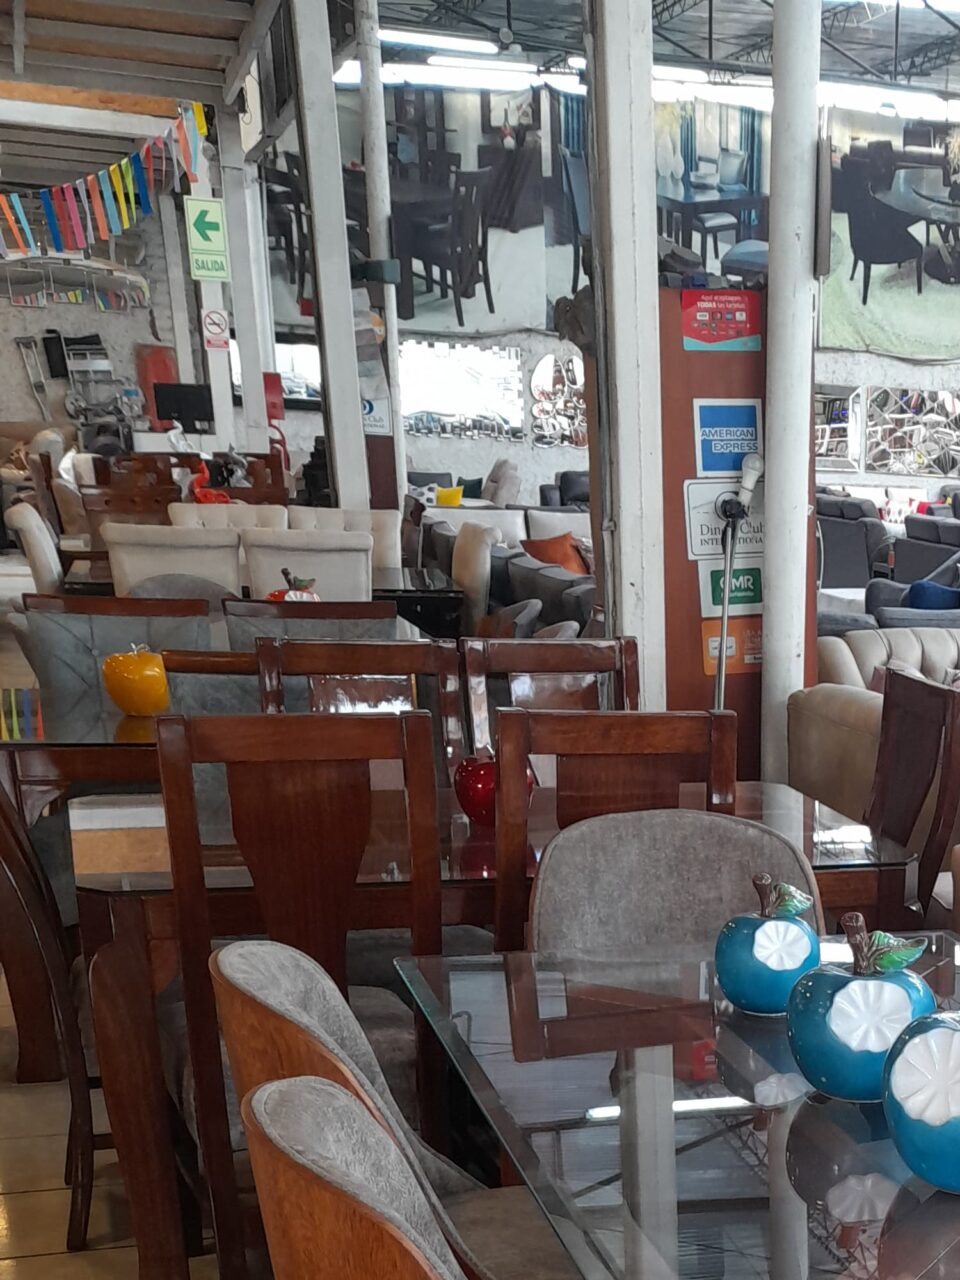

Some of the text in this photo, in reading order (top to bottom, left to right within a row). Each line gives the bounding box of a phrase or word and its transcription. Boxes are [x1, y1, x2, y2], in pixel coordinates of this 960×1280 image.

[194, 258, 225, 272] SALIDA
[700, 428, 755, 440] AMERICAN
[712, 441, 758, 453] EXPRESS
[700, 536, 763, 546] INTETIONA
